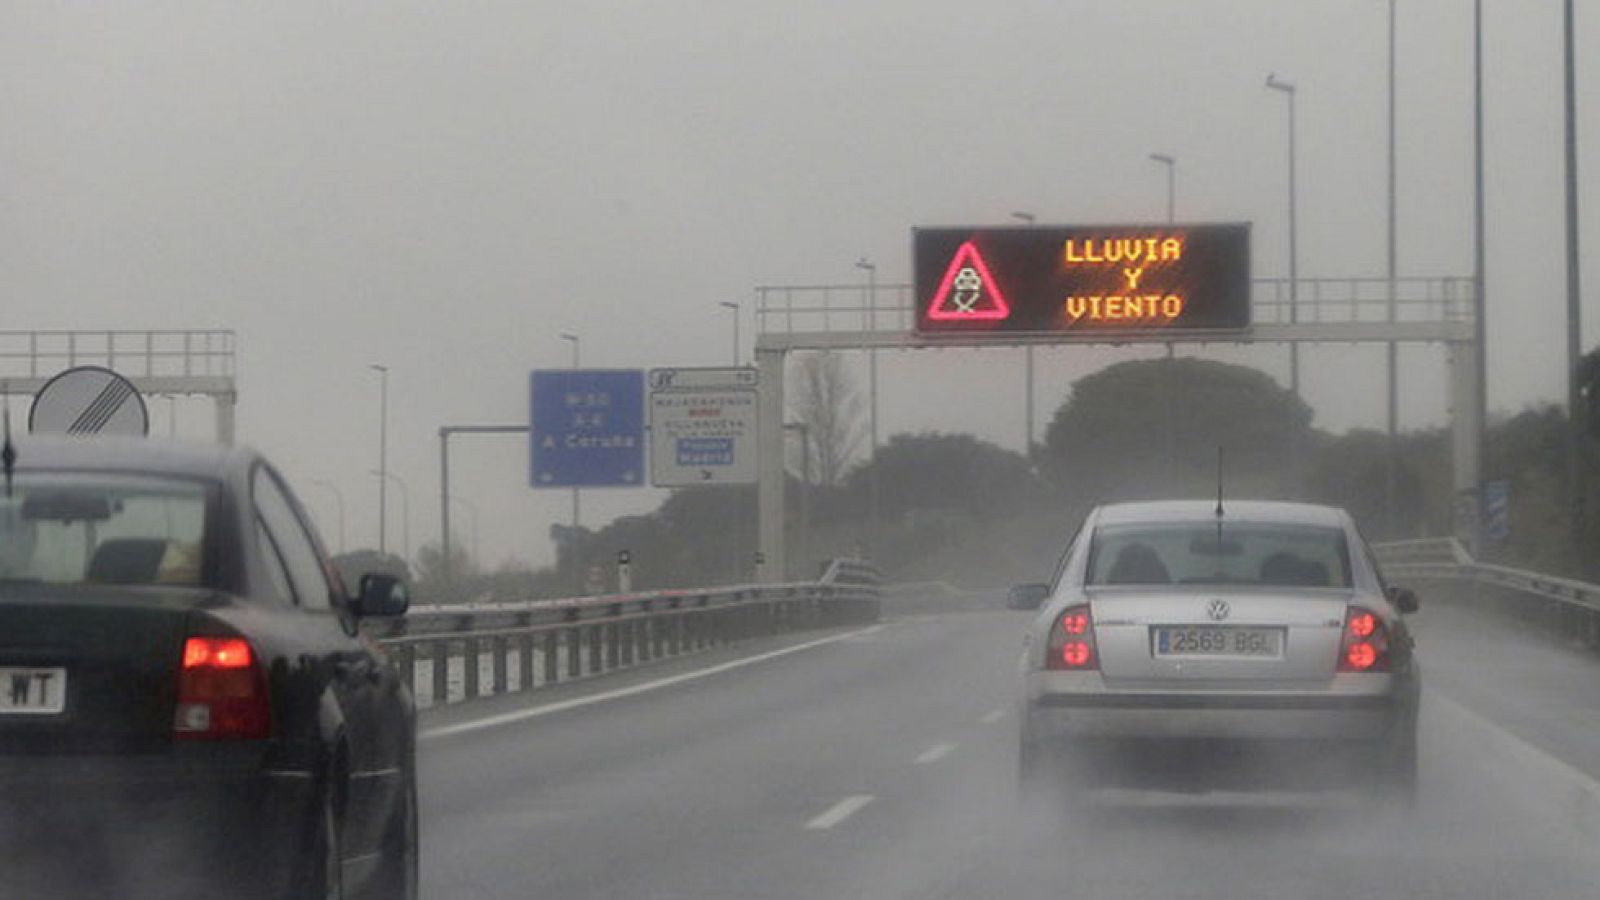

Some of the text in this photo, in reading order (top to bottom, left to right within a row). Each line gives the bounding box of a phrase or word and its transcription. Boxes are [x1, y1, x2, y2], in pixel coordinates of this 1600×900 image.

[1065, 238, 1182, 263] LLUVIA
[1121, 267, 1142, 290] Y
[1065, 296, 1183, 320] VIENTO
[1173, 630, 1273, 653] 2569 BGL
